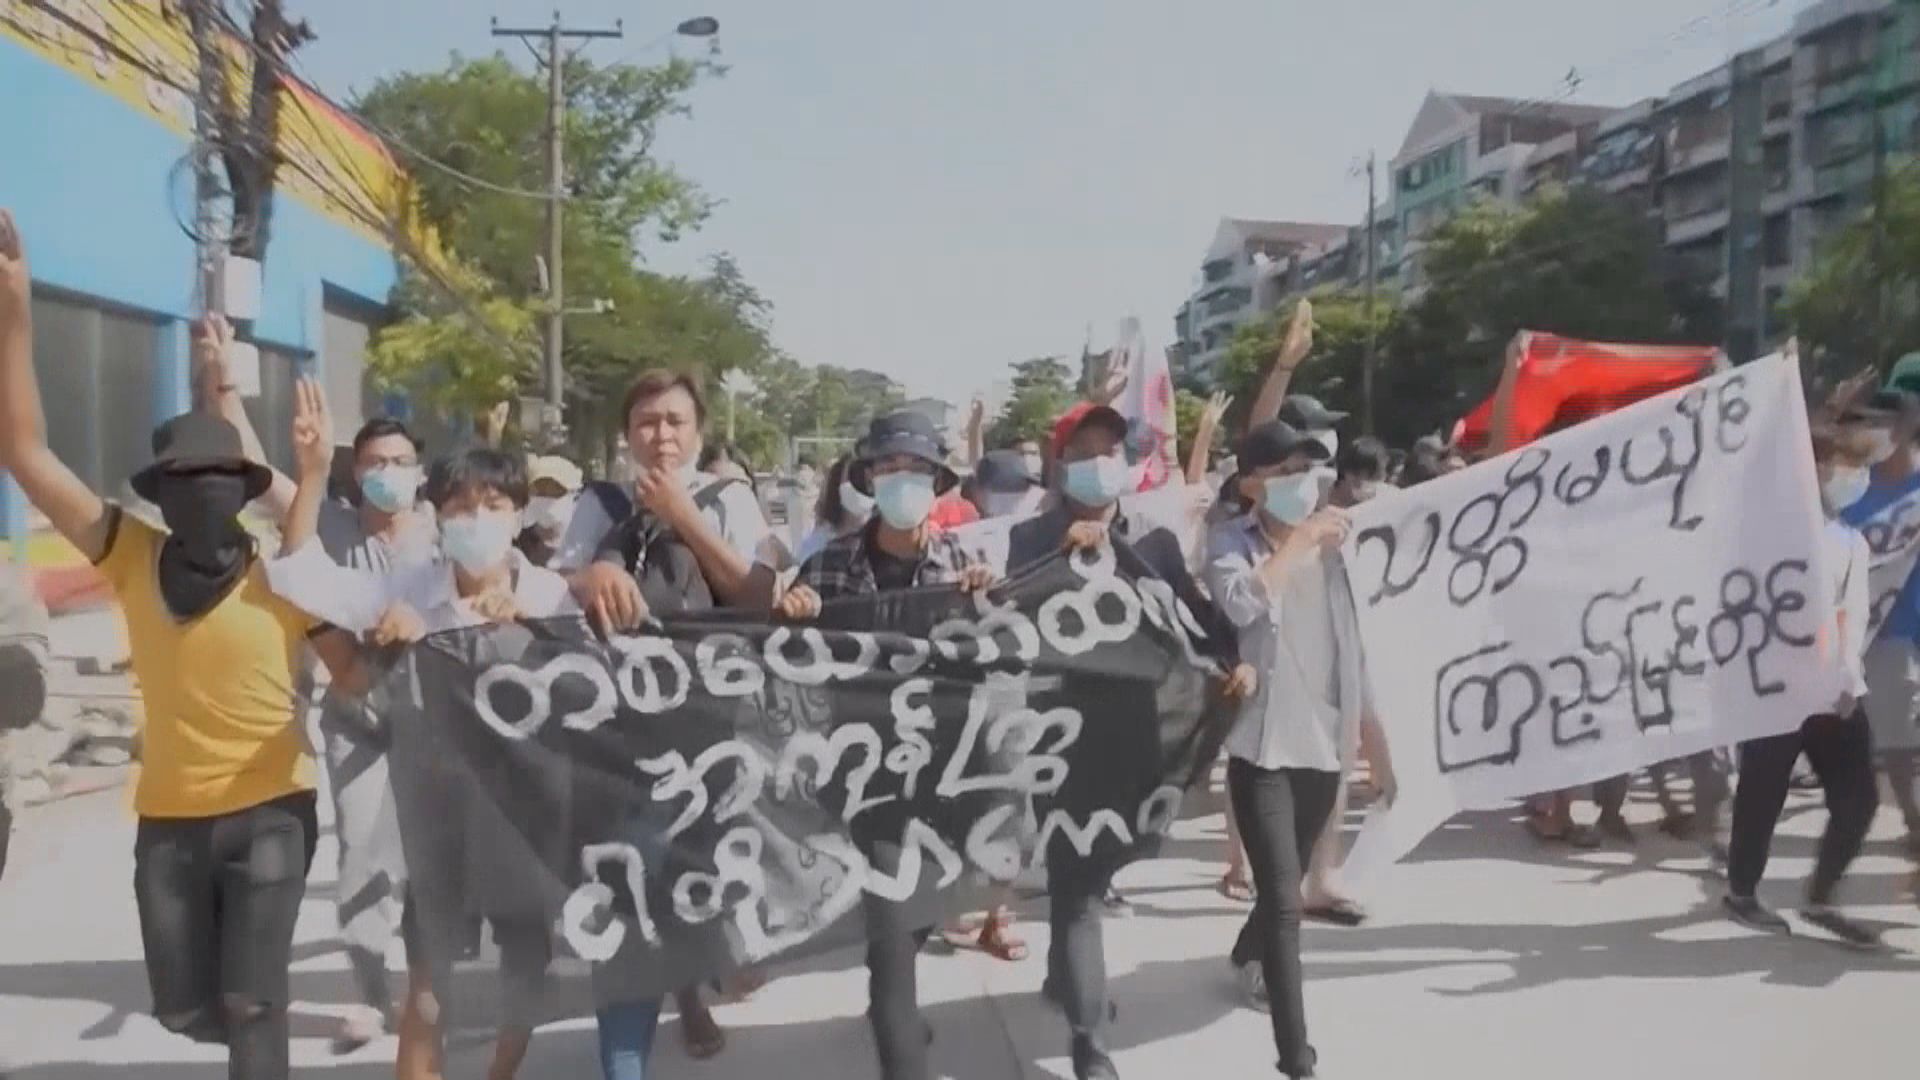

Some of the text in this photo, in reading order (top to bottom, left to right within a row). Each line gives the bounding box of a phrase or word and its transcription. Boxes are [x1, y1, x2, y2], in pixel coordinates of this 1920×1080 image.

[1435, 559, 1816, 773] ကြည့်မြင်တိုင်
